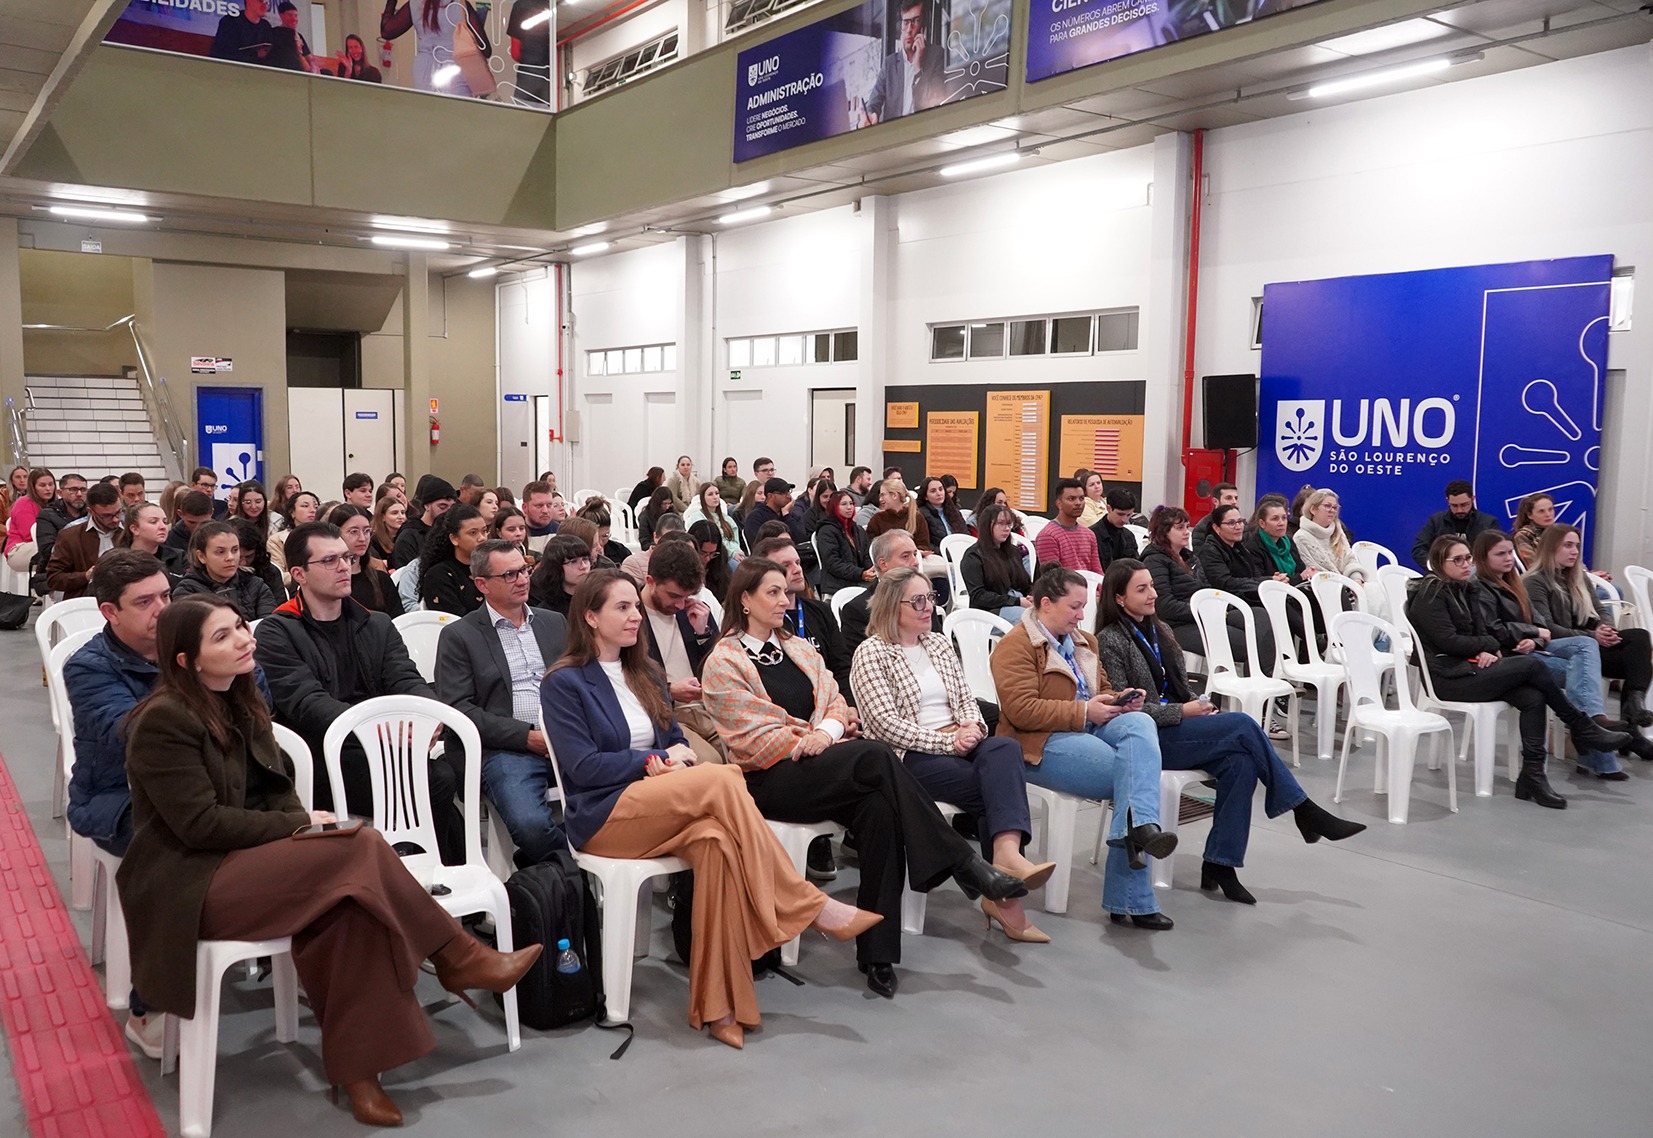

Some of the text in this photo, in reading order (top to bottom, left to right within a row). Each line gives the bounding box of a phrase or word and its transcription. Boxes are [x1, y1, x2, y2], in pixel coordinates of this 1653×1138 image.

[1049, 2, 1160, 44] PARA GRANDES DECISÕES.
[1050, 23, 1061, 32] OS
[1061, 9, 1101, 29] NÚMEROS
[1101, 1, 1130, 17] ABREM
[758, 55, 780, 76] UNO
[747, 72, 824, 110] ADMINISTRAÇÃO
[746, 114, 762, 124] LIDERE
[746, 124, 757, 133] CRIE
[746, 125, 778, 141] TRANSFORME
[782, 117, 806, 130] MERCADO
[1332, 397, 1456, 449] UNO
[1329, 449, 1451, 466] SÃO LOURENÇO
[1329, 463, 1402, 476] DO OESTE
